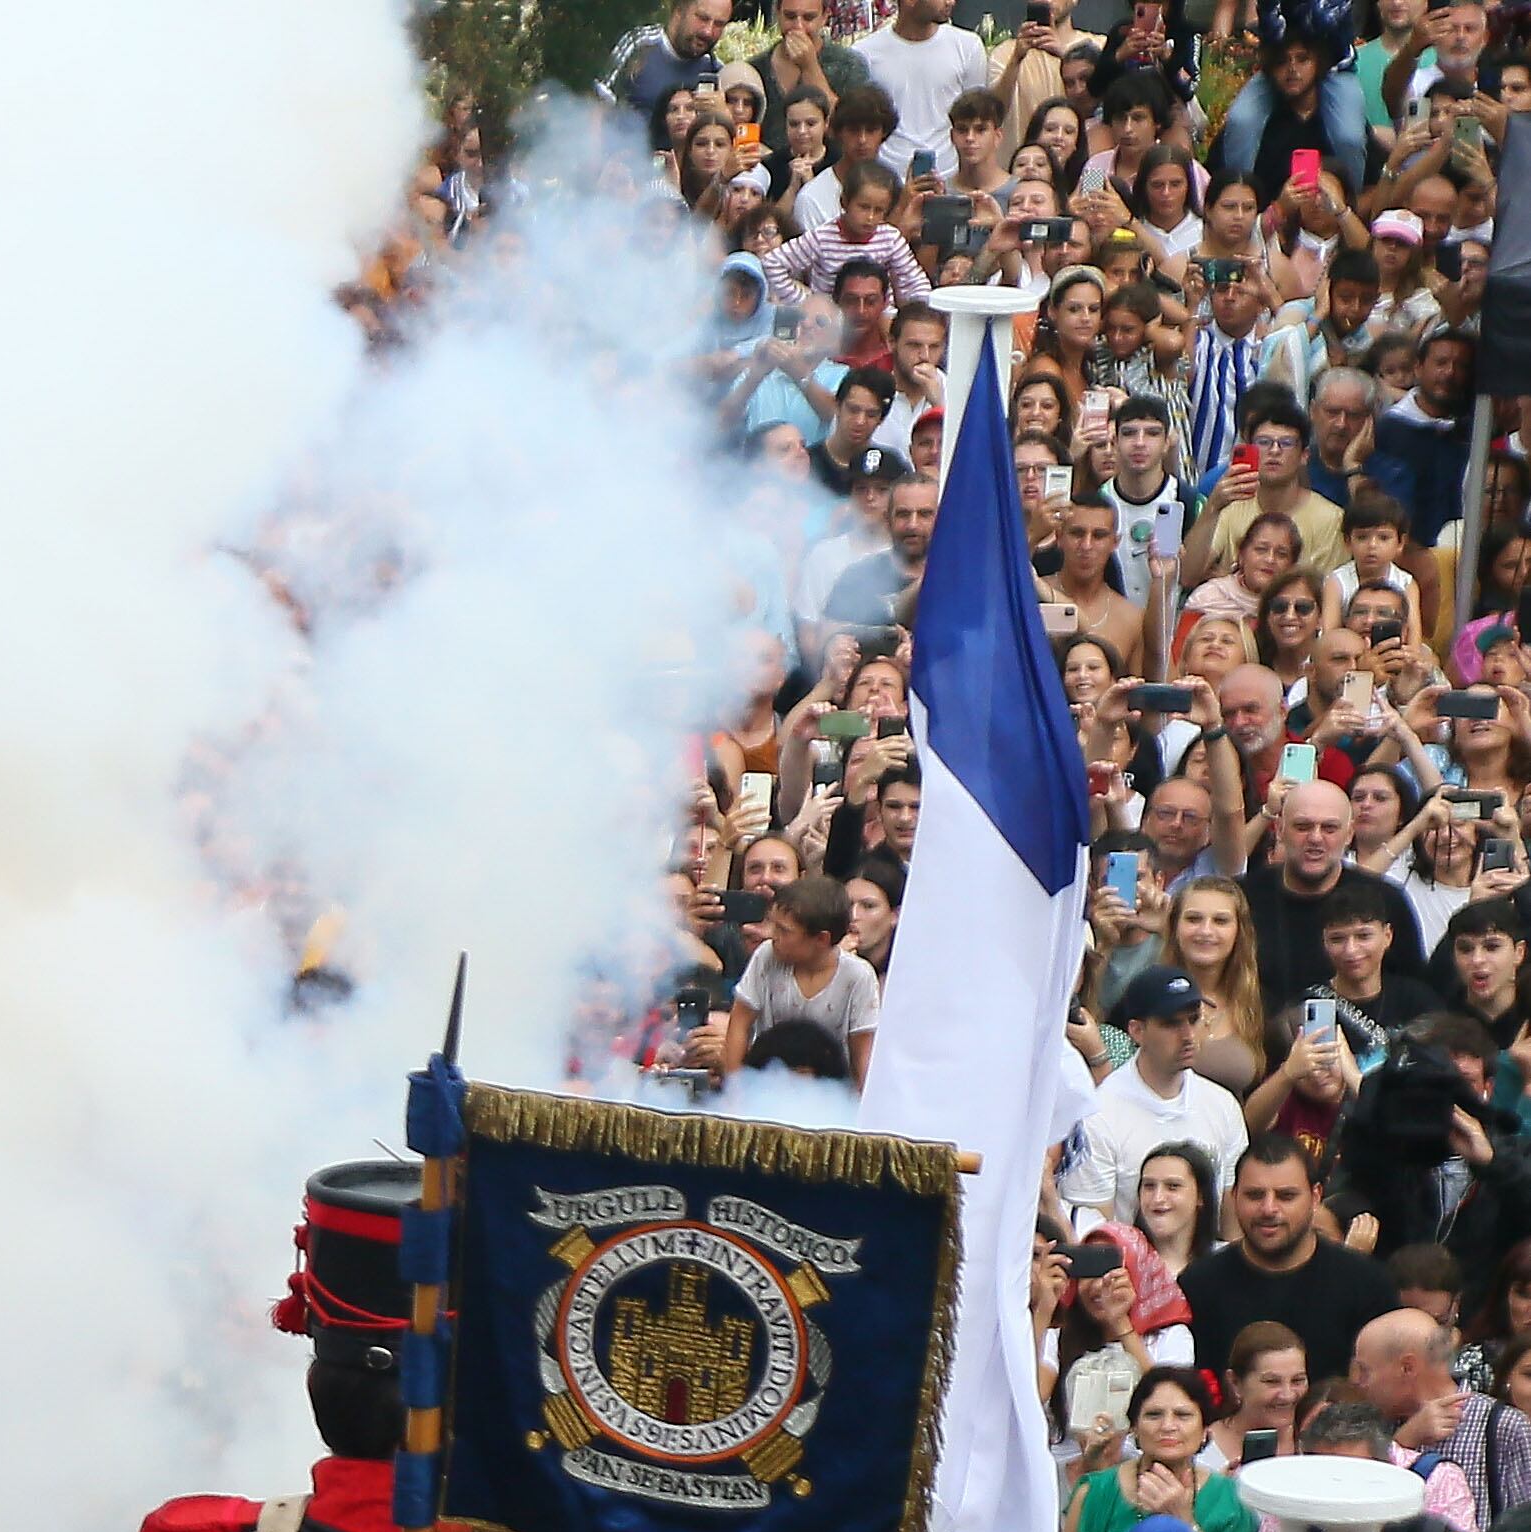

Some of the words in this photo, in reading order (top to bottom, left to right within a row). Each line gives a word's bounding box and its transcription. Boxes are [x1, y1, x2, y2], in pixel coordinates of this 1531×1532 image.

[553, 1190, 682, 1221] URGULL
[712, 1199, 849, 1264] HISTORICO
[571, 1450, 624, 1481] SAN
[629, 1466, 765, 1500] SEBASTIAN
